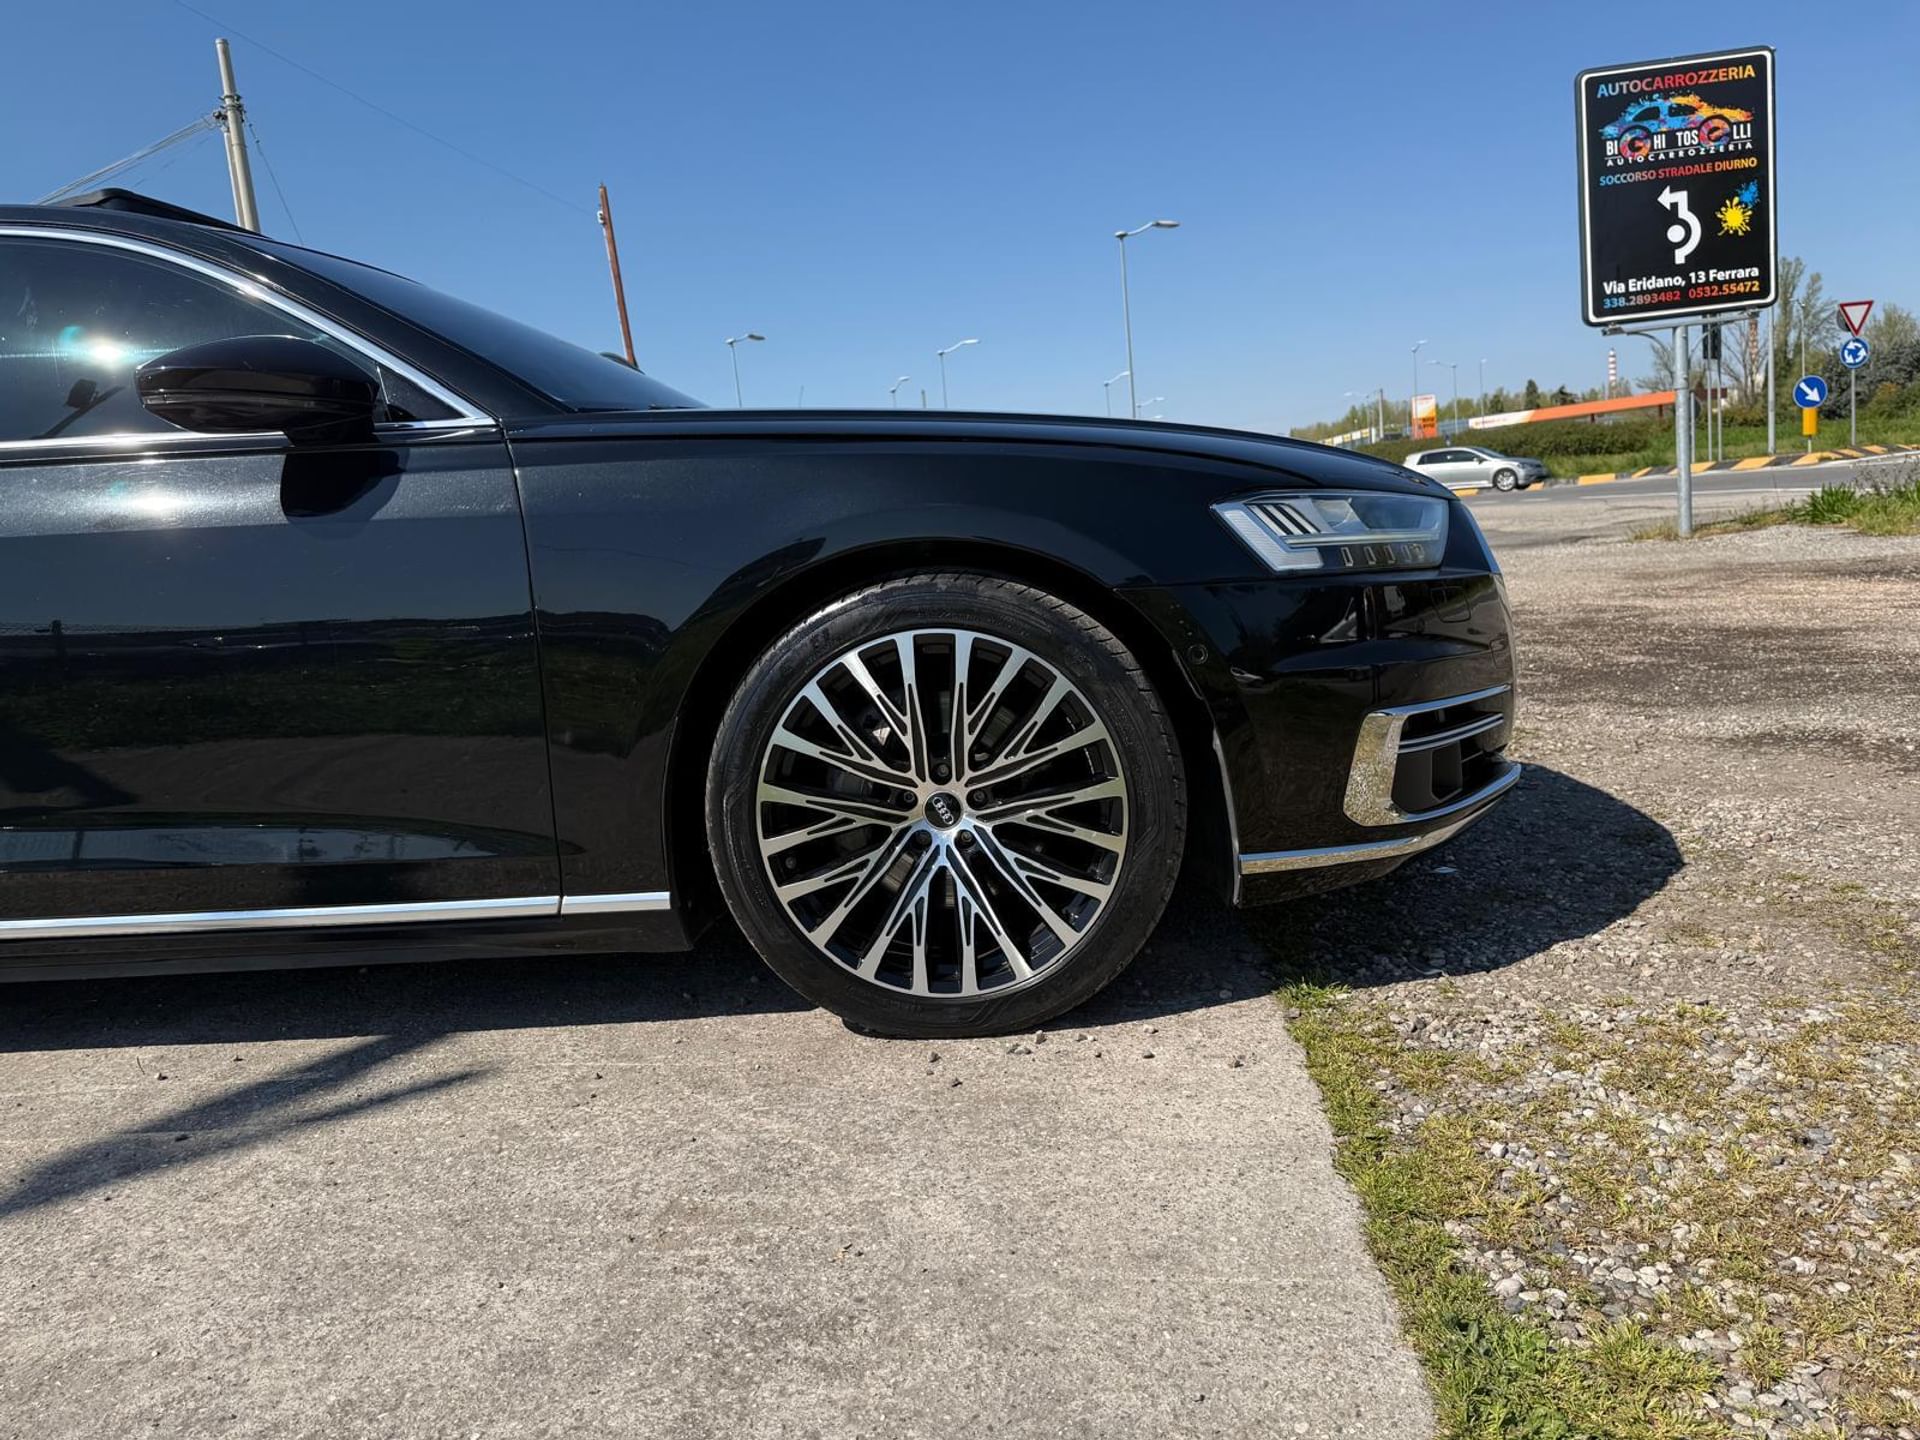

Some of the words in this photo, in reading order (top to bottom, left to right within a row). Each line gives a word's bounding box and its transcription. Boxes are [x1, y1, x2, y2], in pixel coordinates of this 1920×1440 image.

[1597, 65, 1755, 98] AUTOCARROZZERIA
[1606, 126, 1666, 159] BIGHI
[1606, 142, 1753, 167] AUTOCARROZZERIA
[1600, 170, 1656, 187] SOCCORSO
[1658, 163, 1713, 178] STRADALE
[1714, 157, 1758, 172] DIURNO
[1603, 281, 1626, 295] Via
[1628, 274, 1686, 293] Eridano,
[1689, 271, 1706, 283] 13
[1709, 267, 1759, 281] Ferrara
[1603, 290, 1681, 309] 338.2893482
[1688, 281, 1760, 299] 0532.55472
